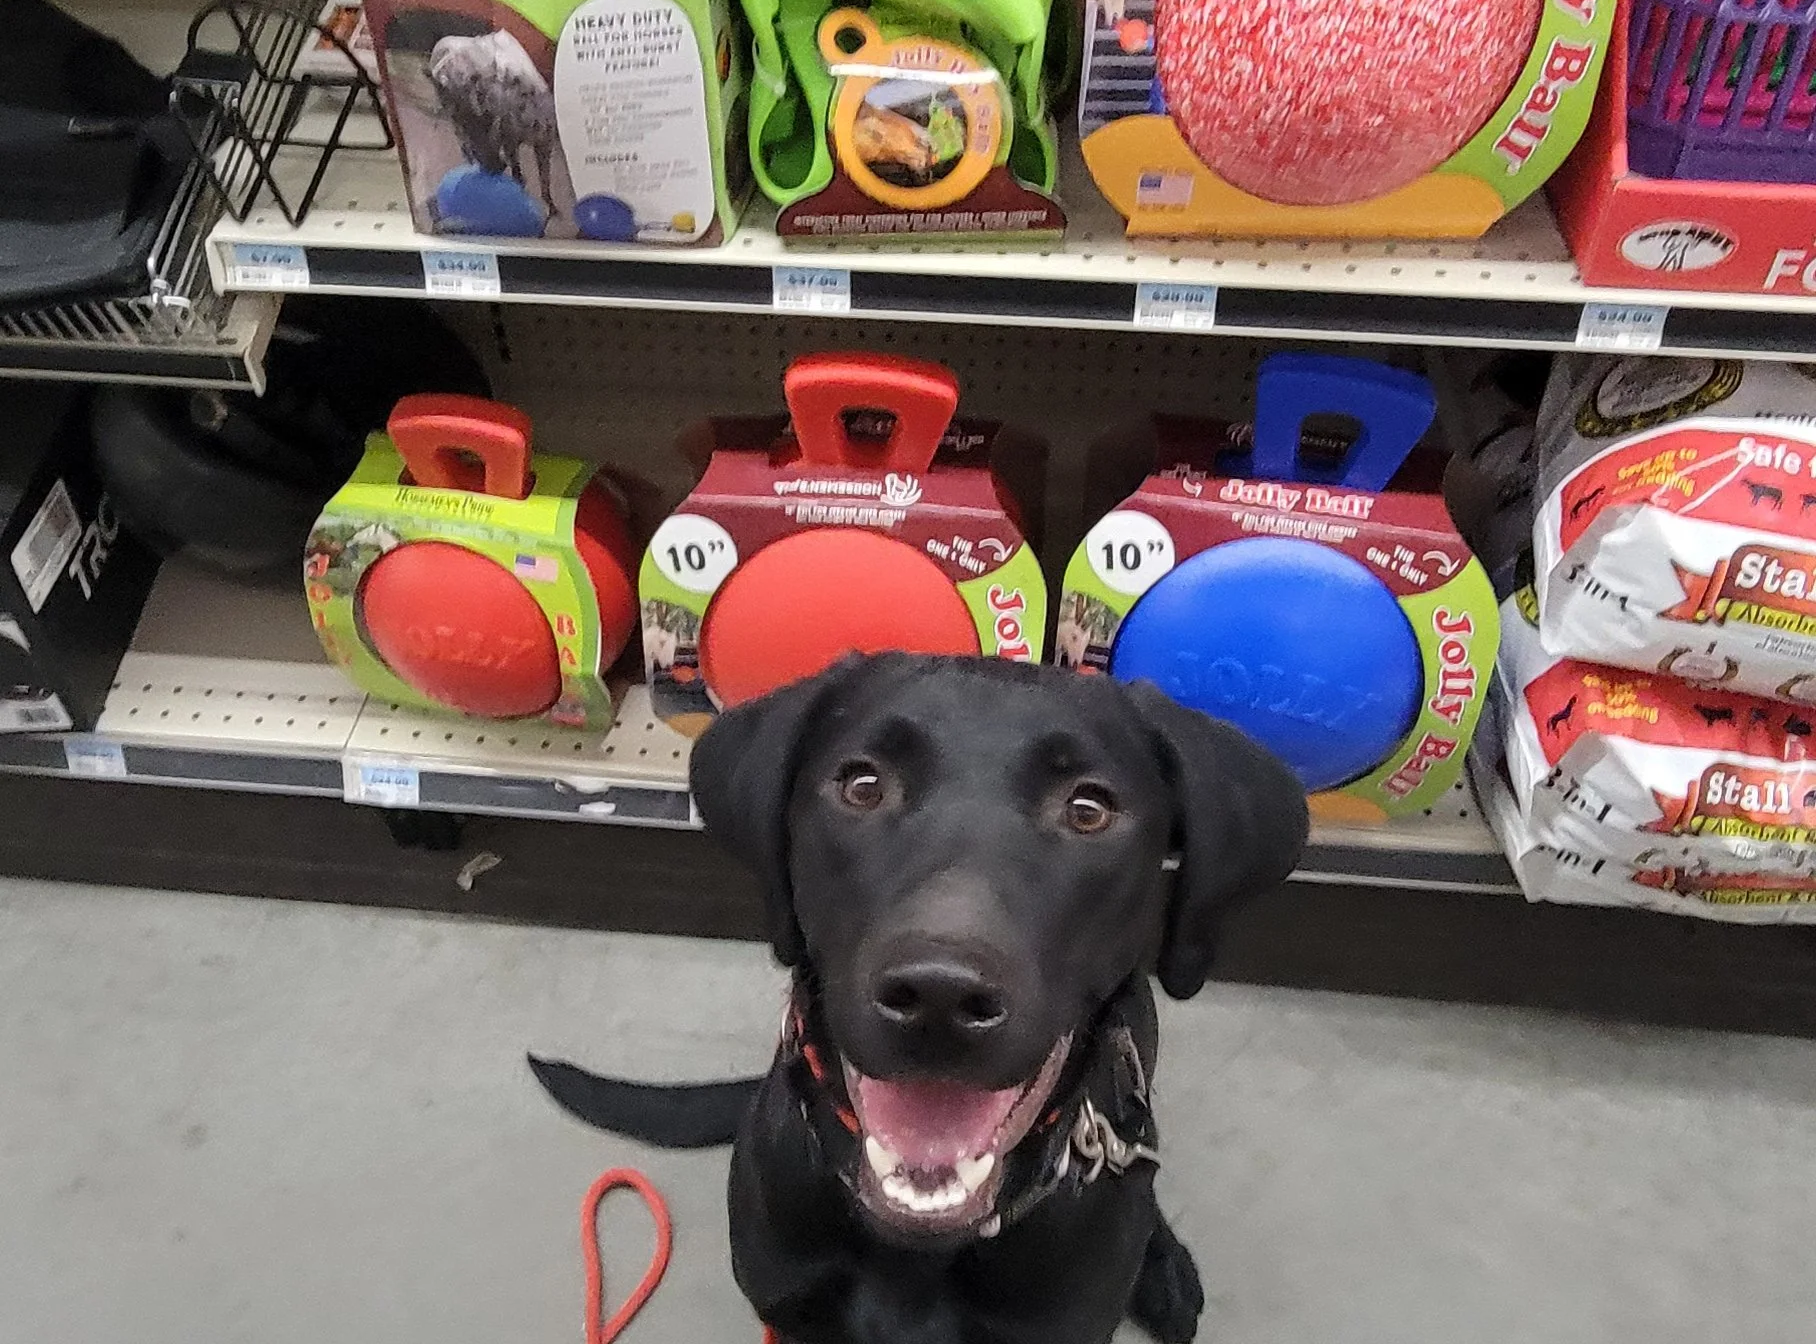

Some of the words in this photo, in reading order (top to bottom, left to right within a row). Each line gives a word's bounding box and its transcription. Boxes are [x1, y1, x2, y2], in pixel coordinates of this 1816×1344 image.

[575, 12, 626, 30] HEAVY
[632, 8, 673, 26] DUTY
[1492, 34, 1597, 175] Ball
[1736, 436, 1803, 476] Safe
[1219, 478, 1302, 512] Jolly
[1305, 487, 1375, 520] Ball
[666, 538, 726, 574] 10"
[926, 538, 948, 561] ONE
[958, 552, 988, 575] ONLY
[1101, 540, 1165, 572] 10"
[1366, 547, 1391, 570] ONE
[1399, 561, 1430, 587] ONLY
[1428, 605, 1477, 726] Jolly
[1706, 770, 1791, 814] Stall
